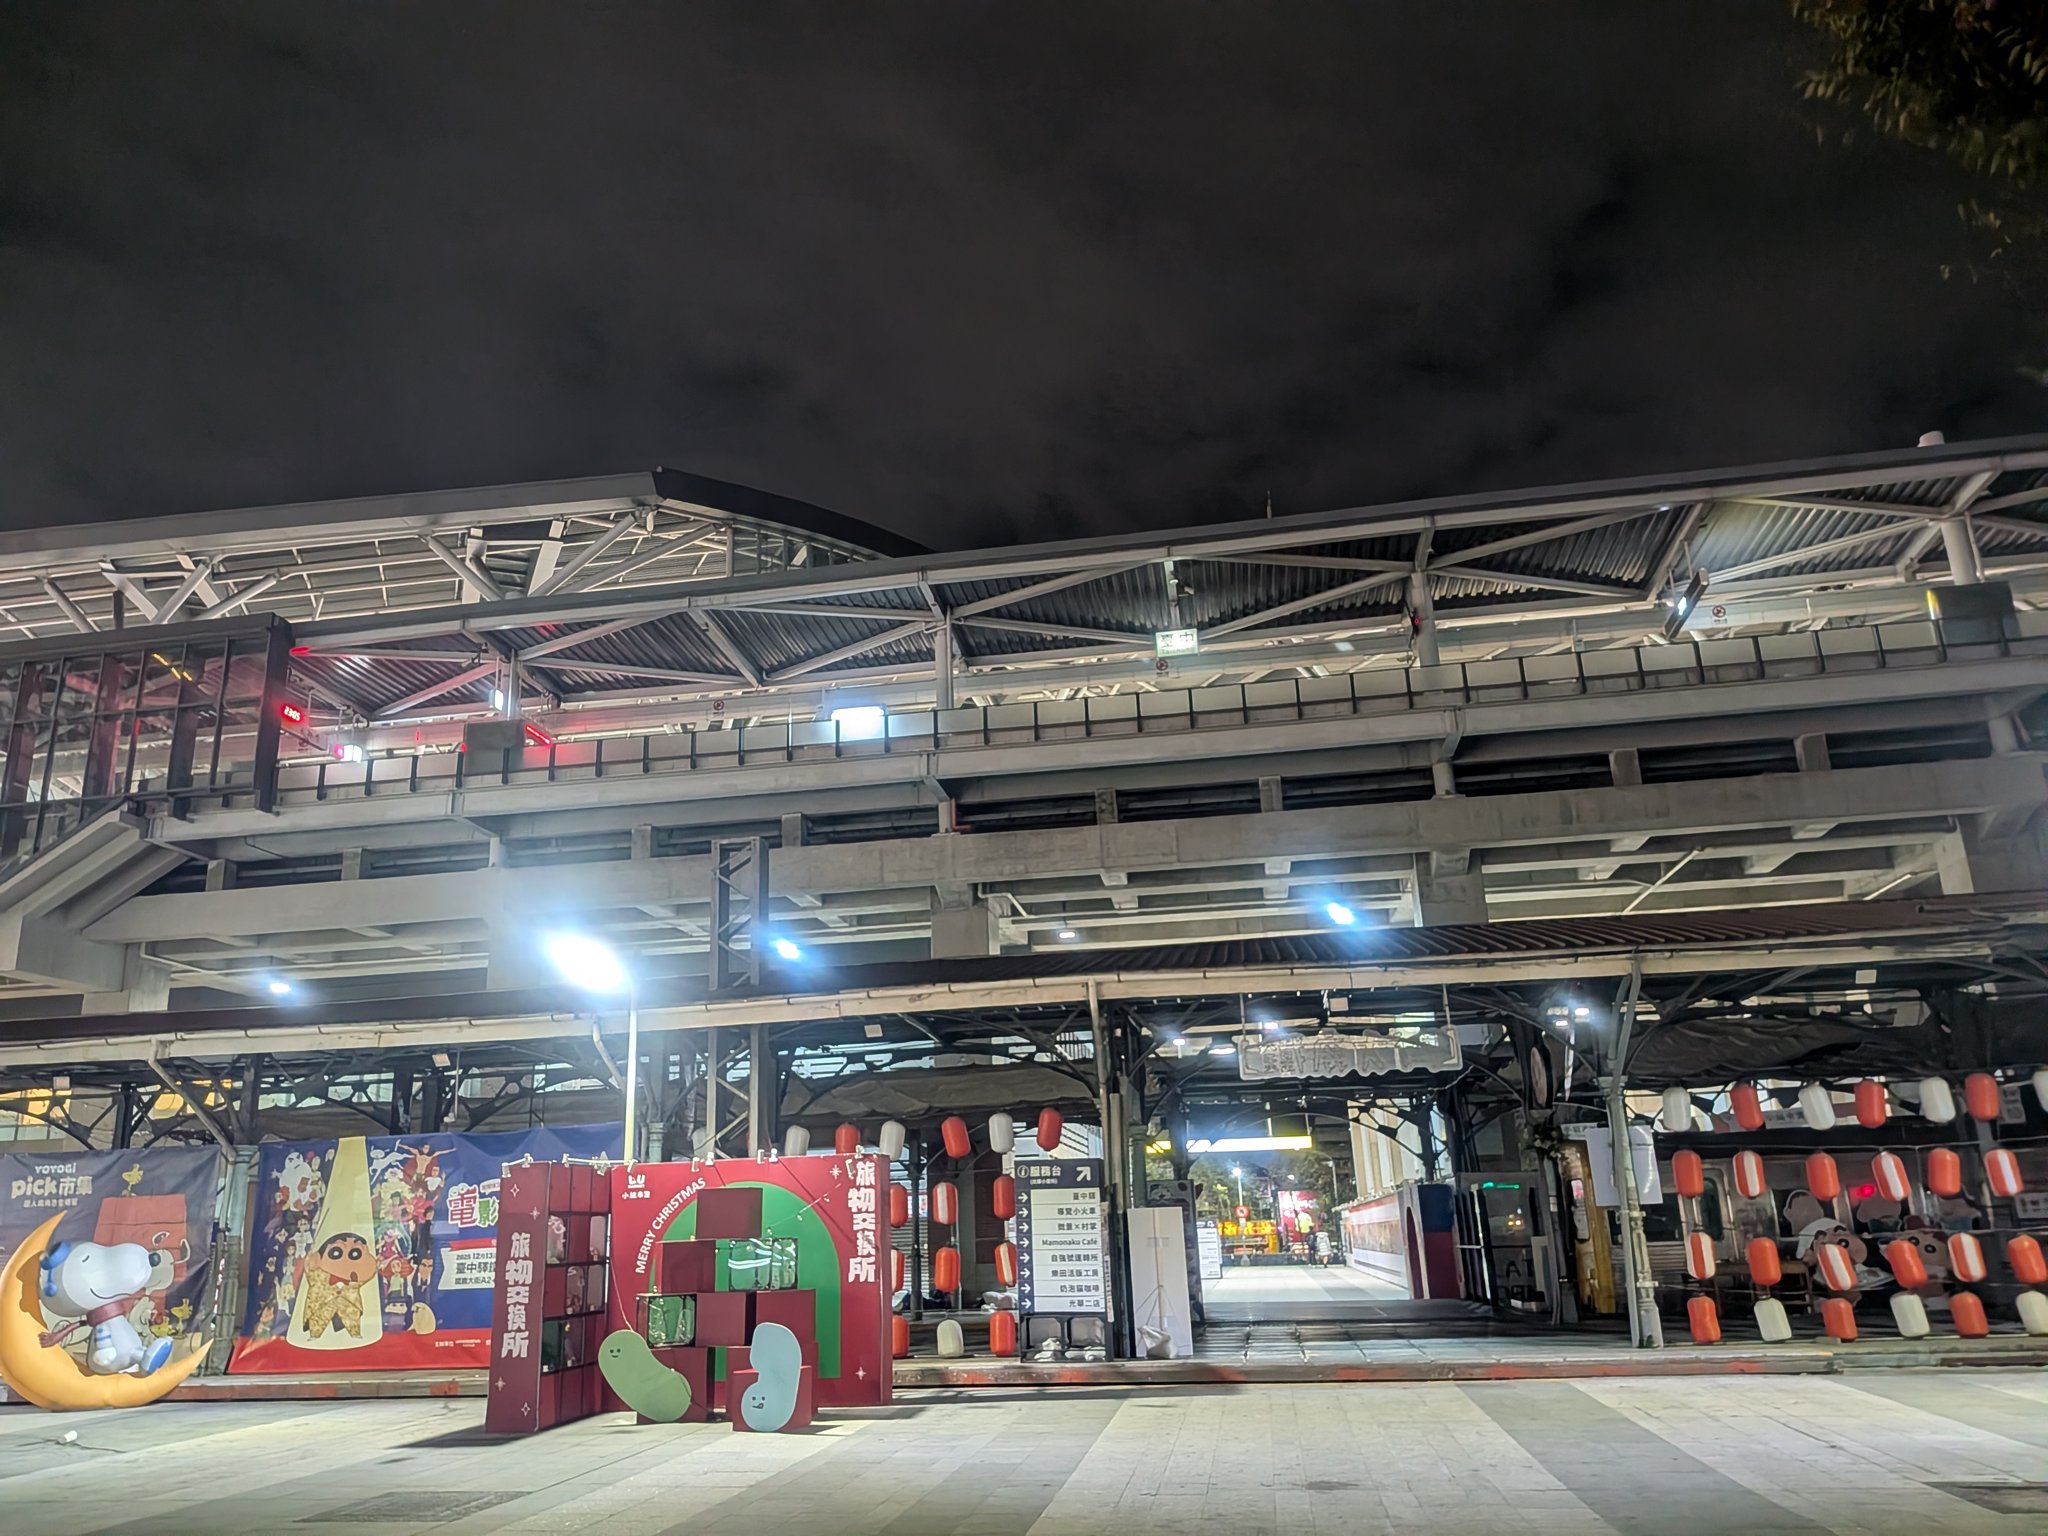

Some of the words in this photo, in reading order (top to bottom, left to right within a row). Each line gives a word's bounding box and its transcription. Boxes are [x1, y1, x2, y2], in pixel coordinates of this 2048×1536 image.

[1030, 1165, 1062, 1177] 服務台
[634, 1229, 657, 1274] MERRY
[651, 1177, 706, 1230] CHRISTMAS
